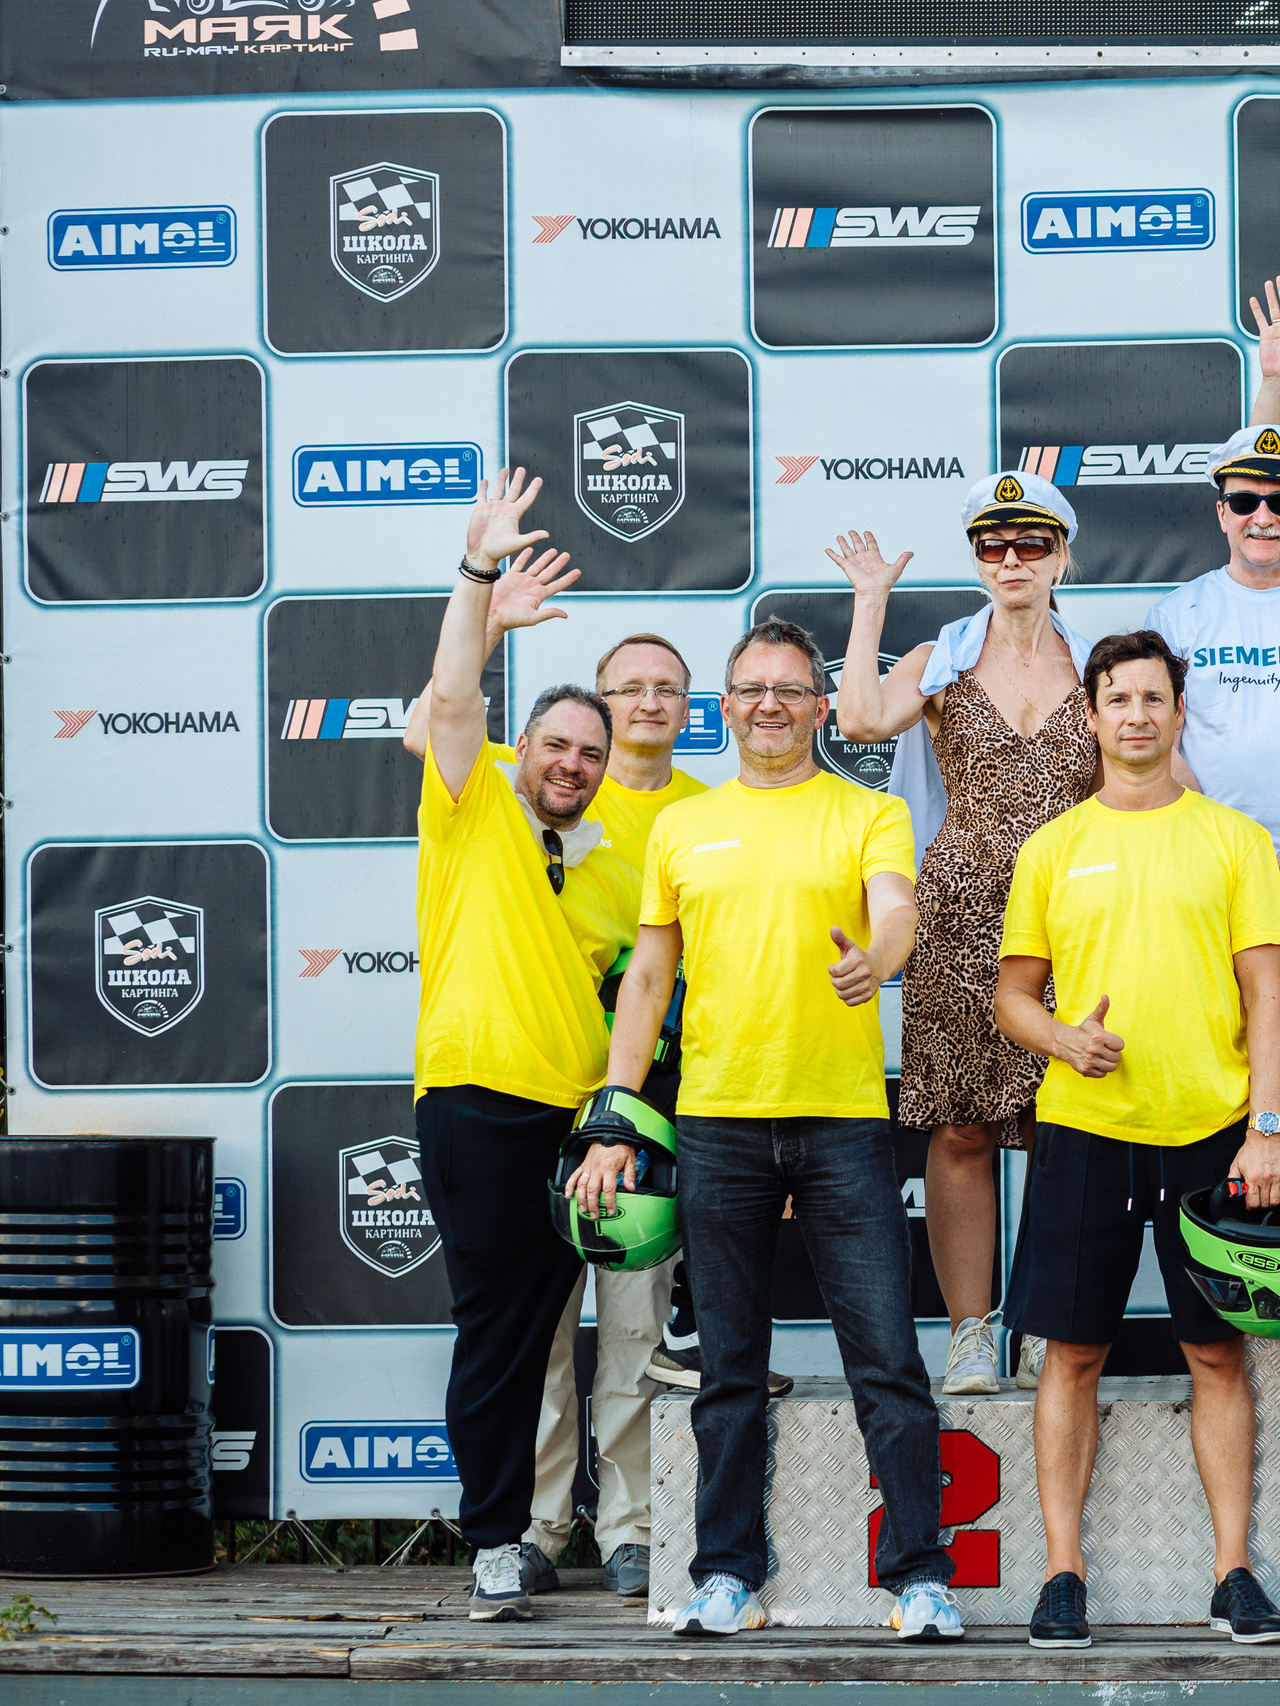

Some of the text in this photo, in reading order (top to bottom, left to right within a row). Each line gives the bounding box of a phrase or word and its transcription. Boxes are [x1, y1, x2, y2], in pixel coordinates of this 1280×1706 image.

[144, 14, 353, 44] МАЯК
[144, 43, 354, 57] RU-MAY КАРТИНГ
[358, 205, 413, 232] Sodi
[577, 217, 722, 240] YOKOHAMA
[830, 206, 981, 247] SWS
[343, 235, 427, 252] ШКОЛА
[357, 253, 414, 264] КАРТИНГА
[601, 444, 658, 471] Sodi
[820, 456, 965, 480] YOKOHAMA
[101, 459, 249, 501] SWS
[587, 475, 672, 491] ШКОЛА
[601, 494, 659, 503] КАРТИНГА
[98, 710, 240, 735] YOKOHAMA
[1067, 861, 1118, 879] SIEMENS
[122, 939, 177, 966] Sodi
[108, 969, 192, 986] ШКОЛА
[121, 988, 179, 998] КАРТИНГА
[366, 1179, 421, 1206] Sodi
[352, 1209, 436, 1226] ШКОЛА
[365, 1229, 423, 1238] КАРТИНГА
[309, 1435, 457, 1469] AIMO
